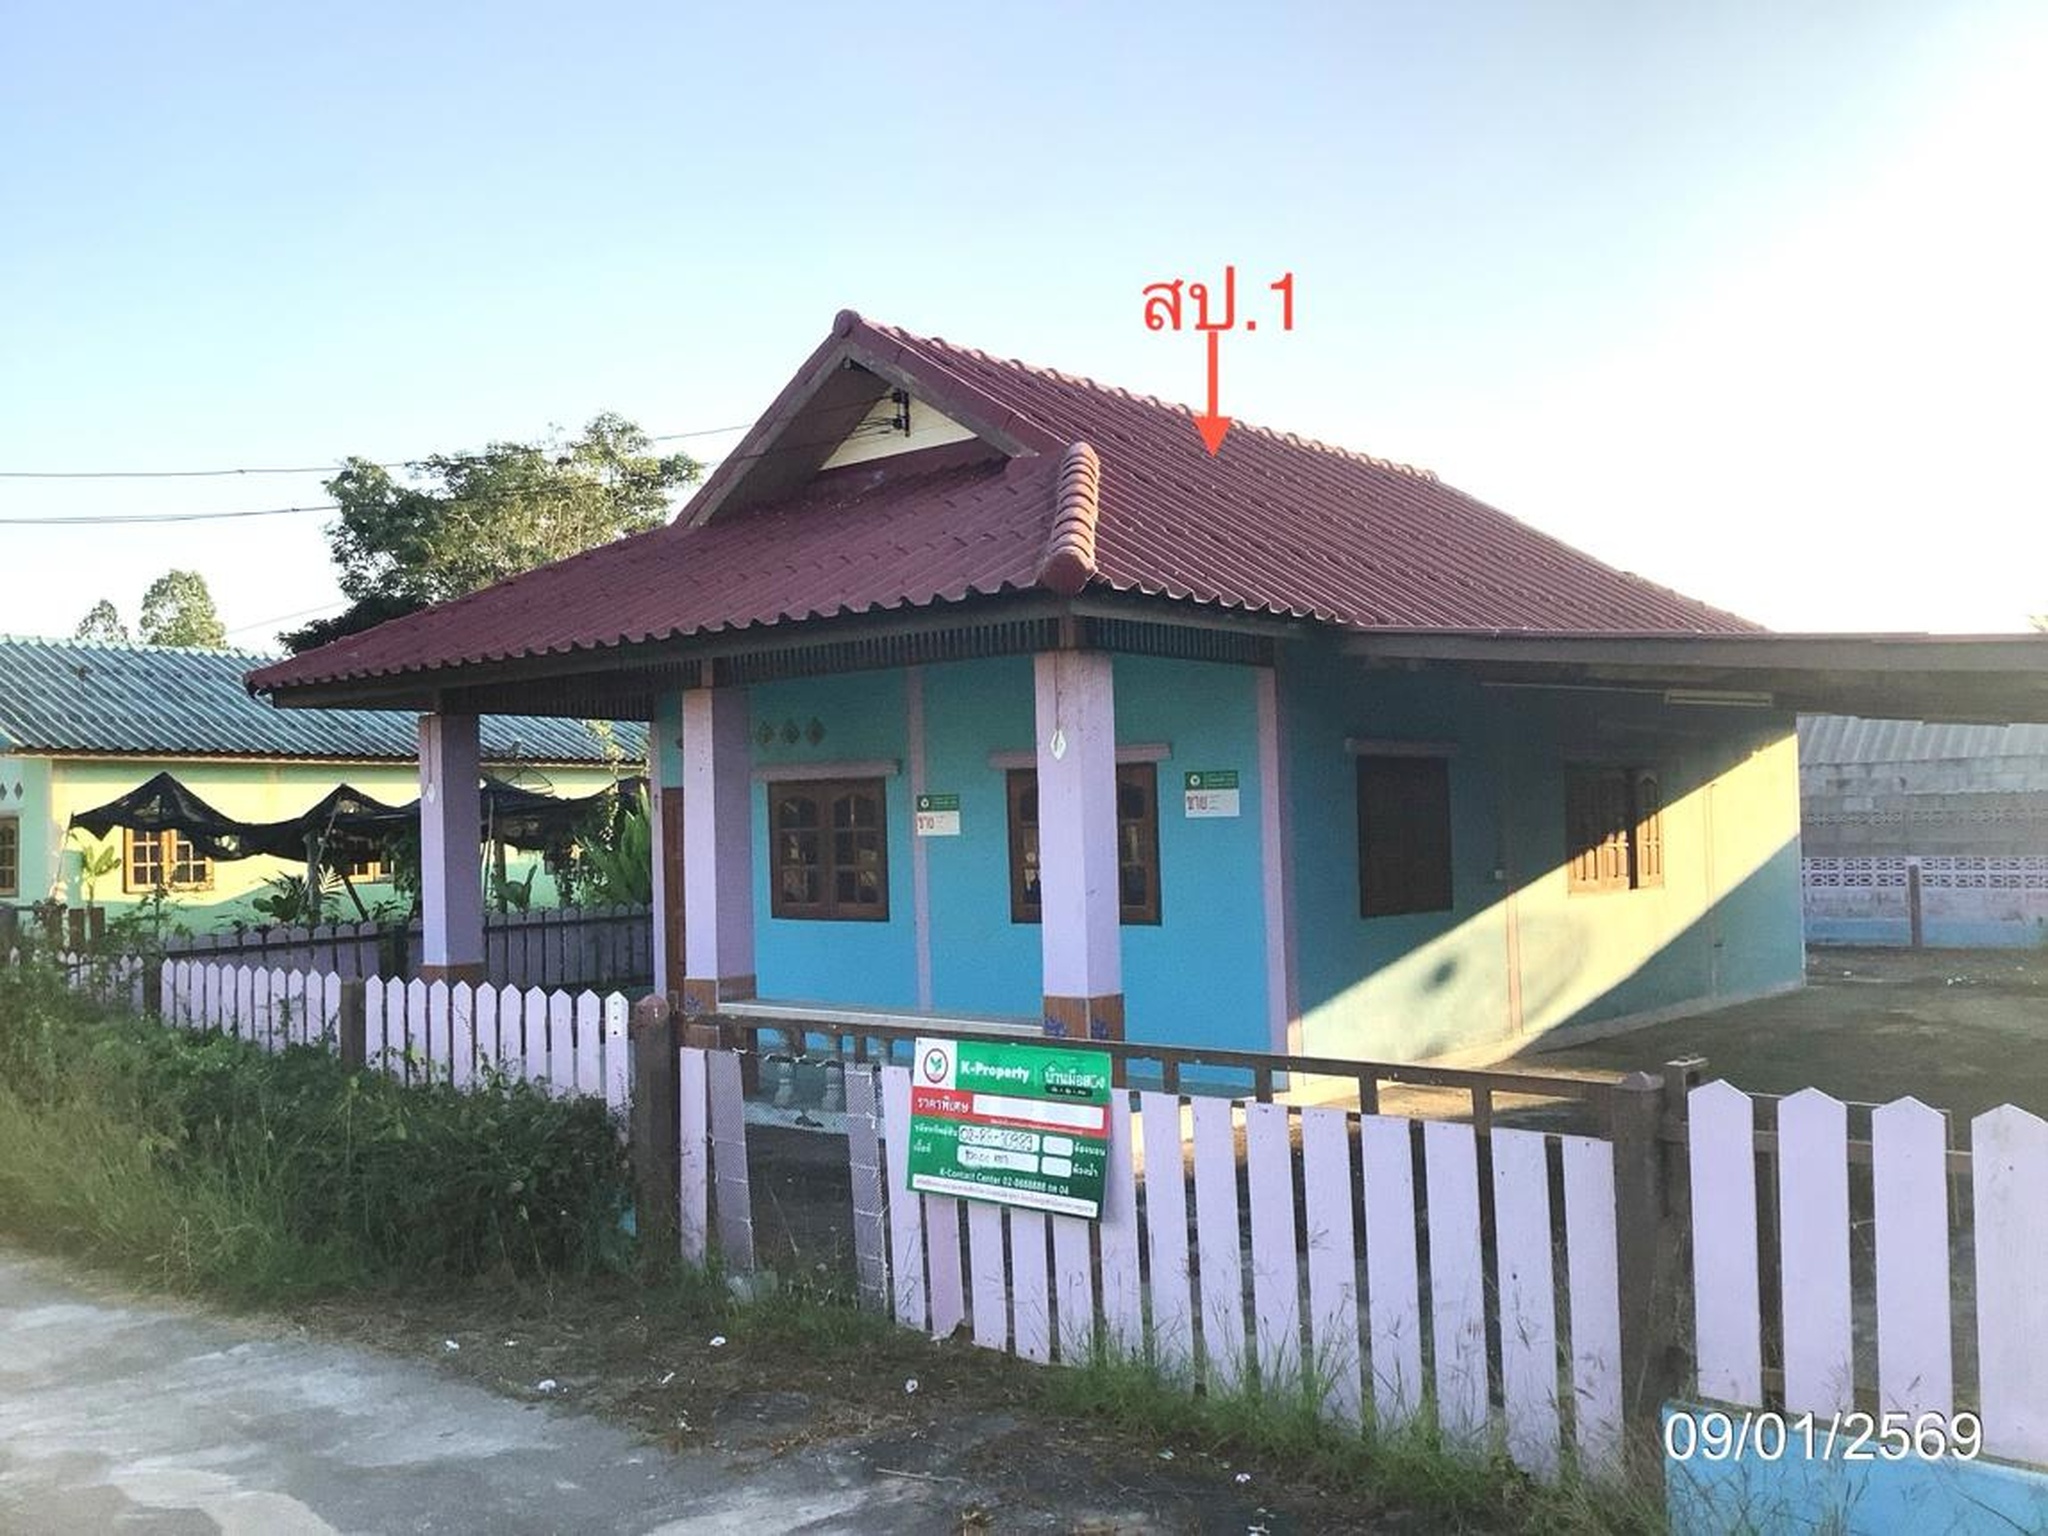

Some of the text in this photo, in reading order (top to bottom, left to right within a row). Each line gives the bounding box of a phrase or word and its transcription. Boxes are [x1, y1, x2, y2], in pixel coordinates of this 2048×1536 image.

[960, 1060, 1029, 1084] K-Property
[917, 1095, 969, 1113] ราคาพิเศษ
[1074, 1142, 1106, 1157] ห้องนอน
[1072, 1163, 1099, 1178] ห้องน้ำ
[940, 1167, 975, 1181] K-Contact
[976, 1172, 1001, 1185] Center
[1058, 1185, 1070, 1196] 04
